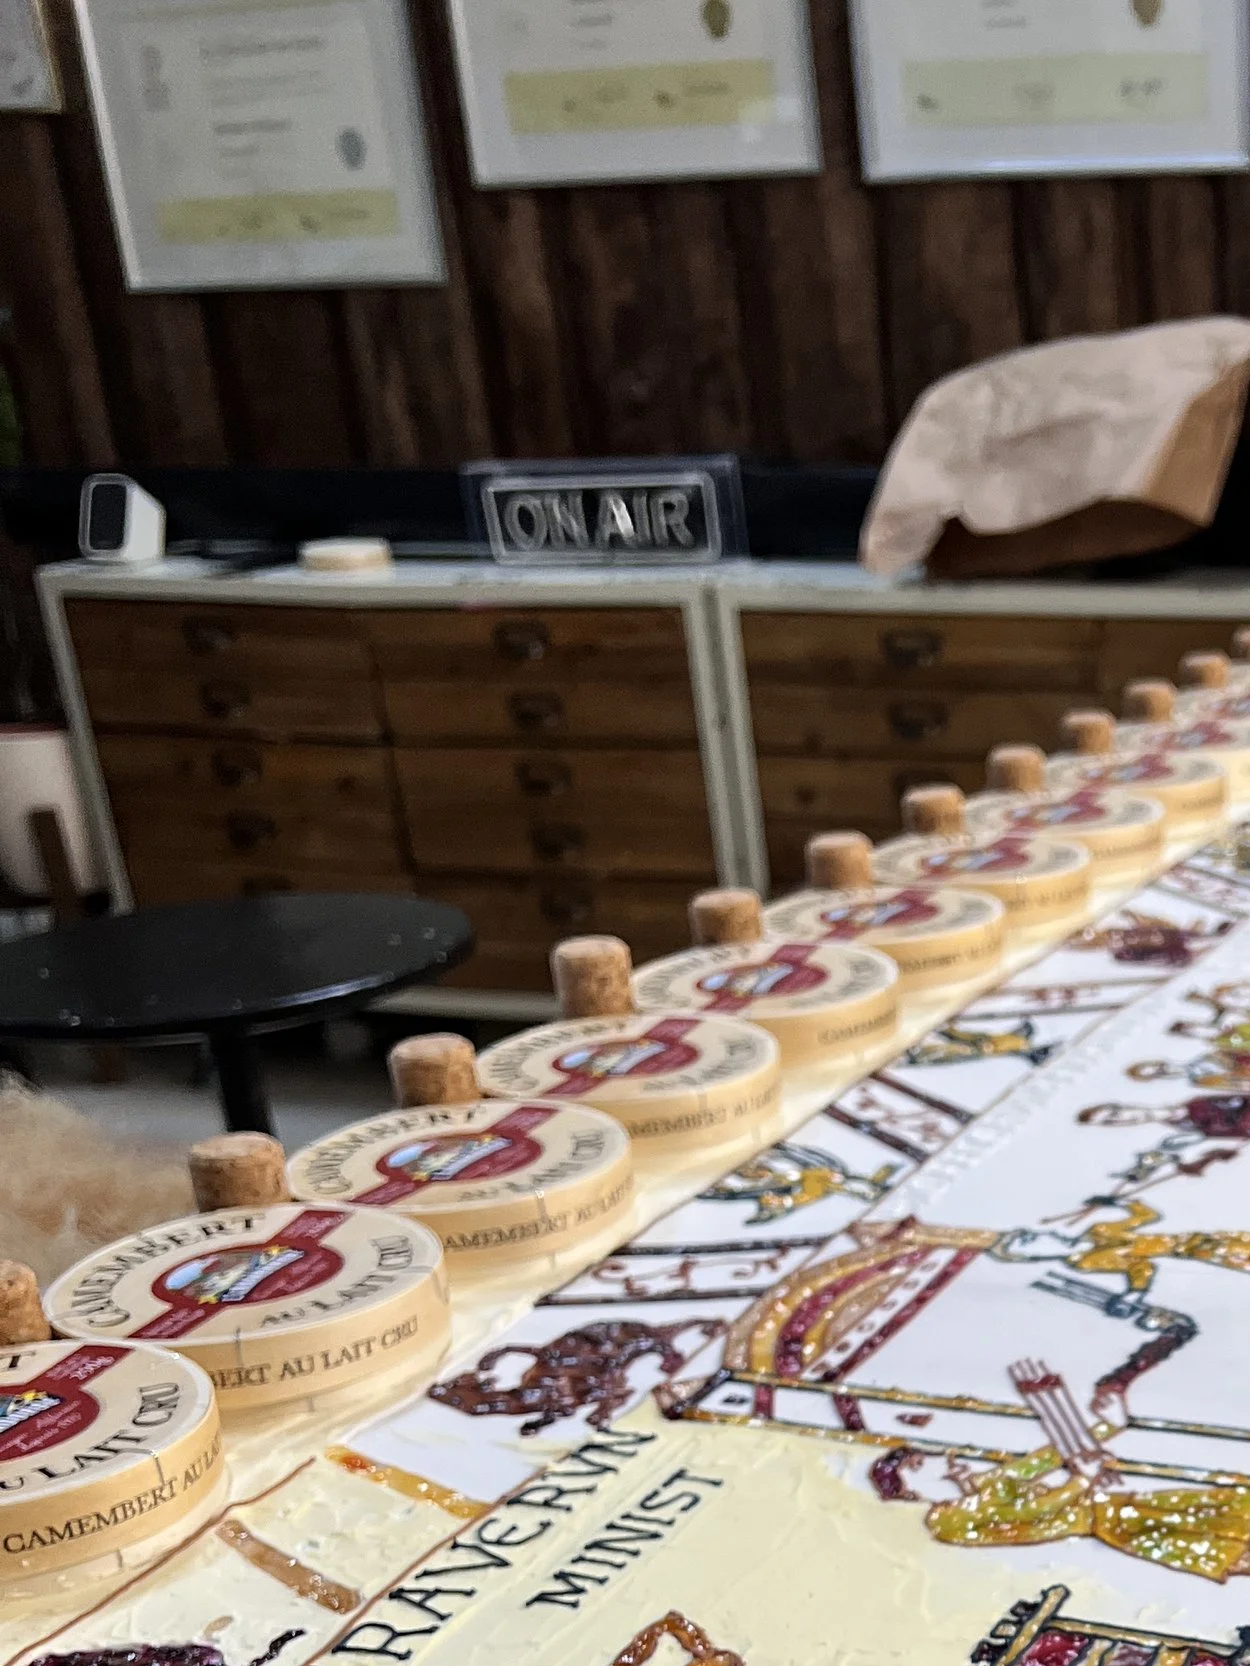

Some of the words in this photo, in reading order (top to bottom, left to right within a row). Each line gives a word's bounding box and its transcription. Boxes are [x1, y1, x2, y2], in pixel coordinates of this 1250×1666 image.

[504, 490, 589, 550] ON
[595, 486, 695, 549] AIR
[279, 1354, 315, 1382] AU
[322, 1335, 378, 1371] LAIT
[380, 1314, 420, 1348] CRU
[132, 1381, 181, 1427] CRU
[3, 1474, 179, 1554] CAMEMBERT
[524, 1466, 724, 1609] MINIST
